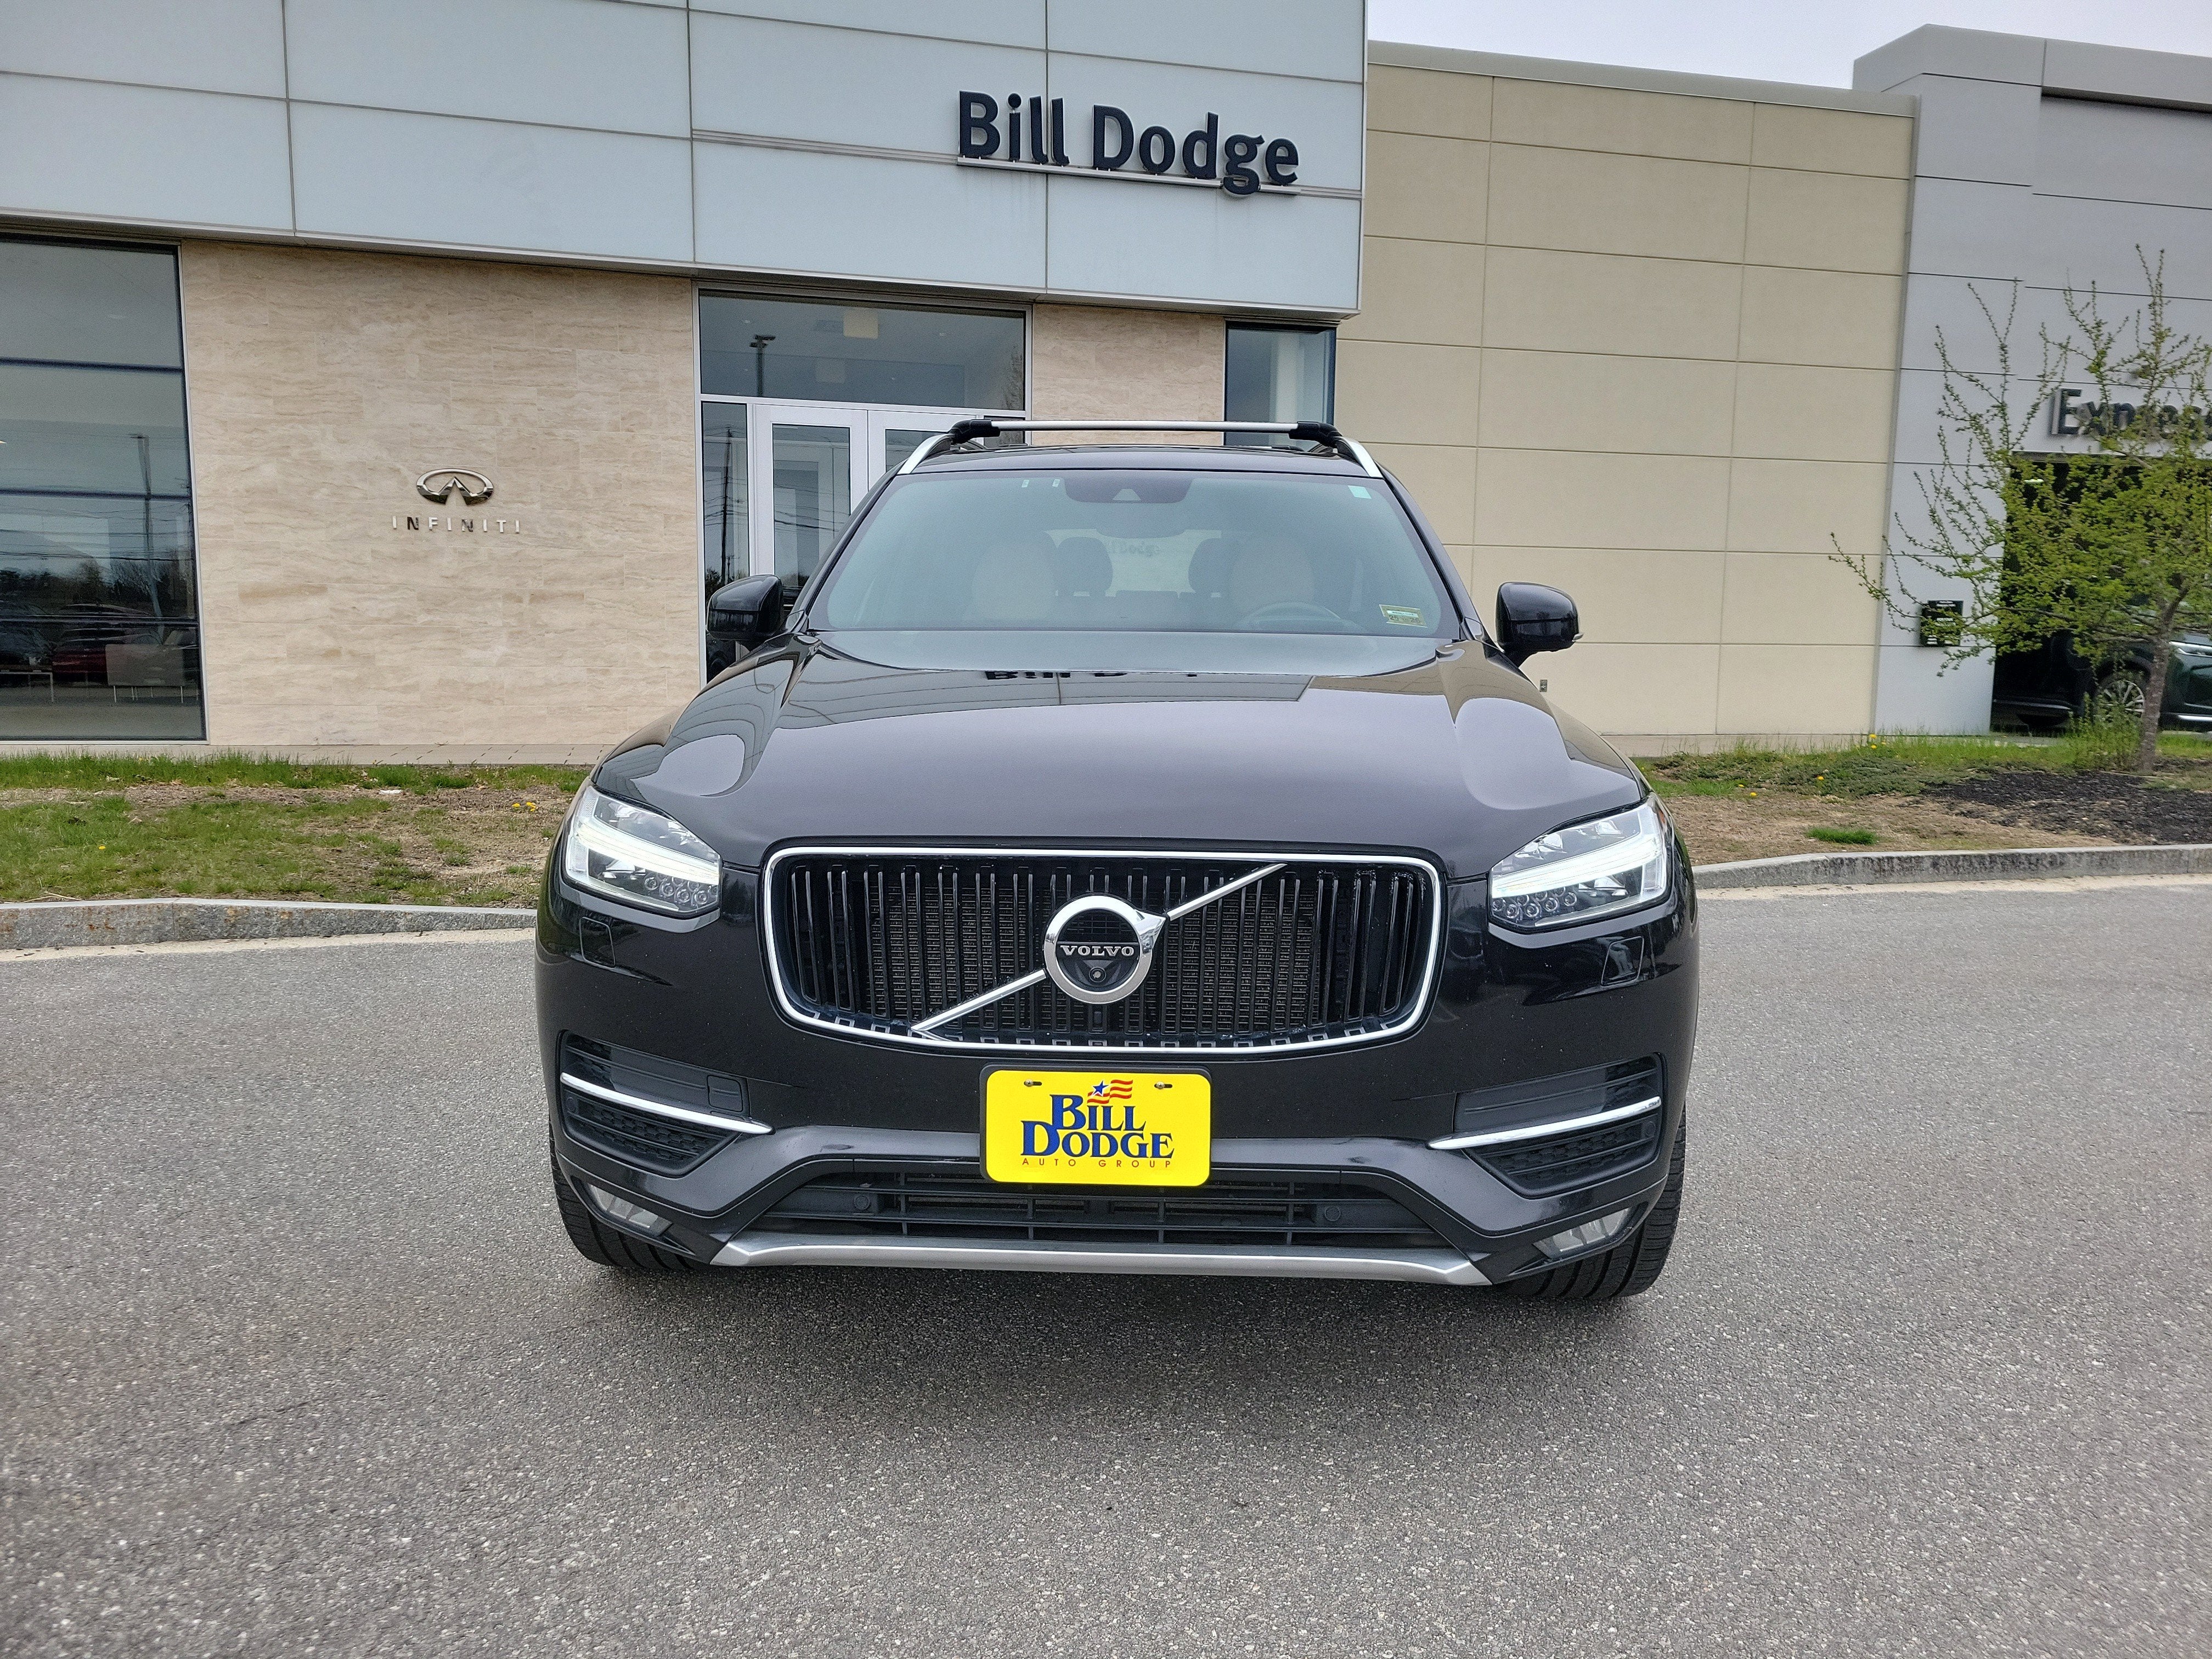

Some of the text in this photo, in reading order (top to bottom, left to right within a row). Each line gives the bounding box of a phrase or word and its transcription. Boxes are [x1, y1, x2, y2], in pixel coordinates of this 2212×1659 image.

[959, 90, 1300, 196] Bill Dodge
[391, 516, 520, 533] INFINITI
[1060, 945, 1135, 957] VOLVO
[1049, 1094, 1146, 1131] BILL
[1020, 1120, 1175, 1159] DODGE
[1022, 1158, 1171, 1168] AUTO GROUP
